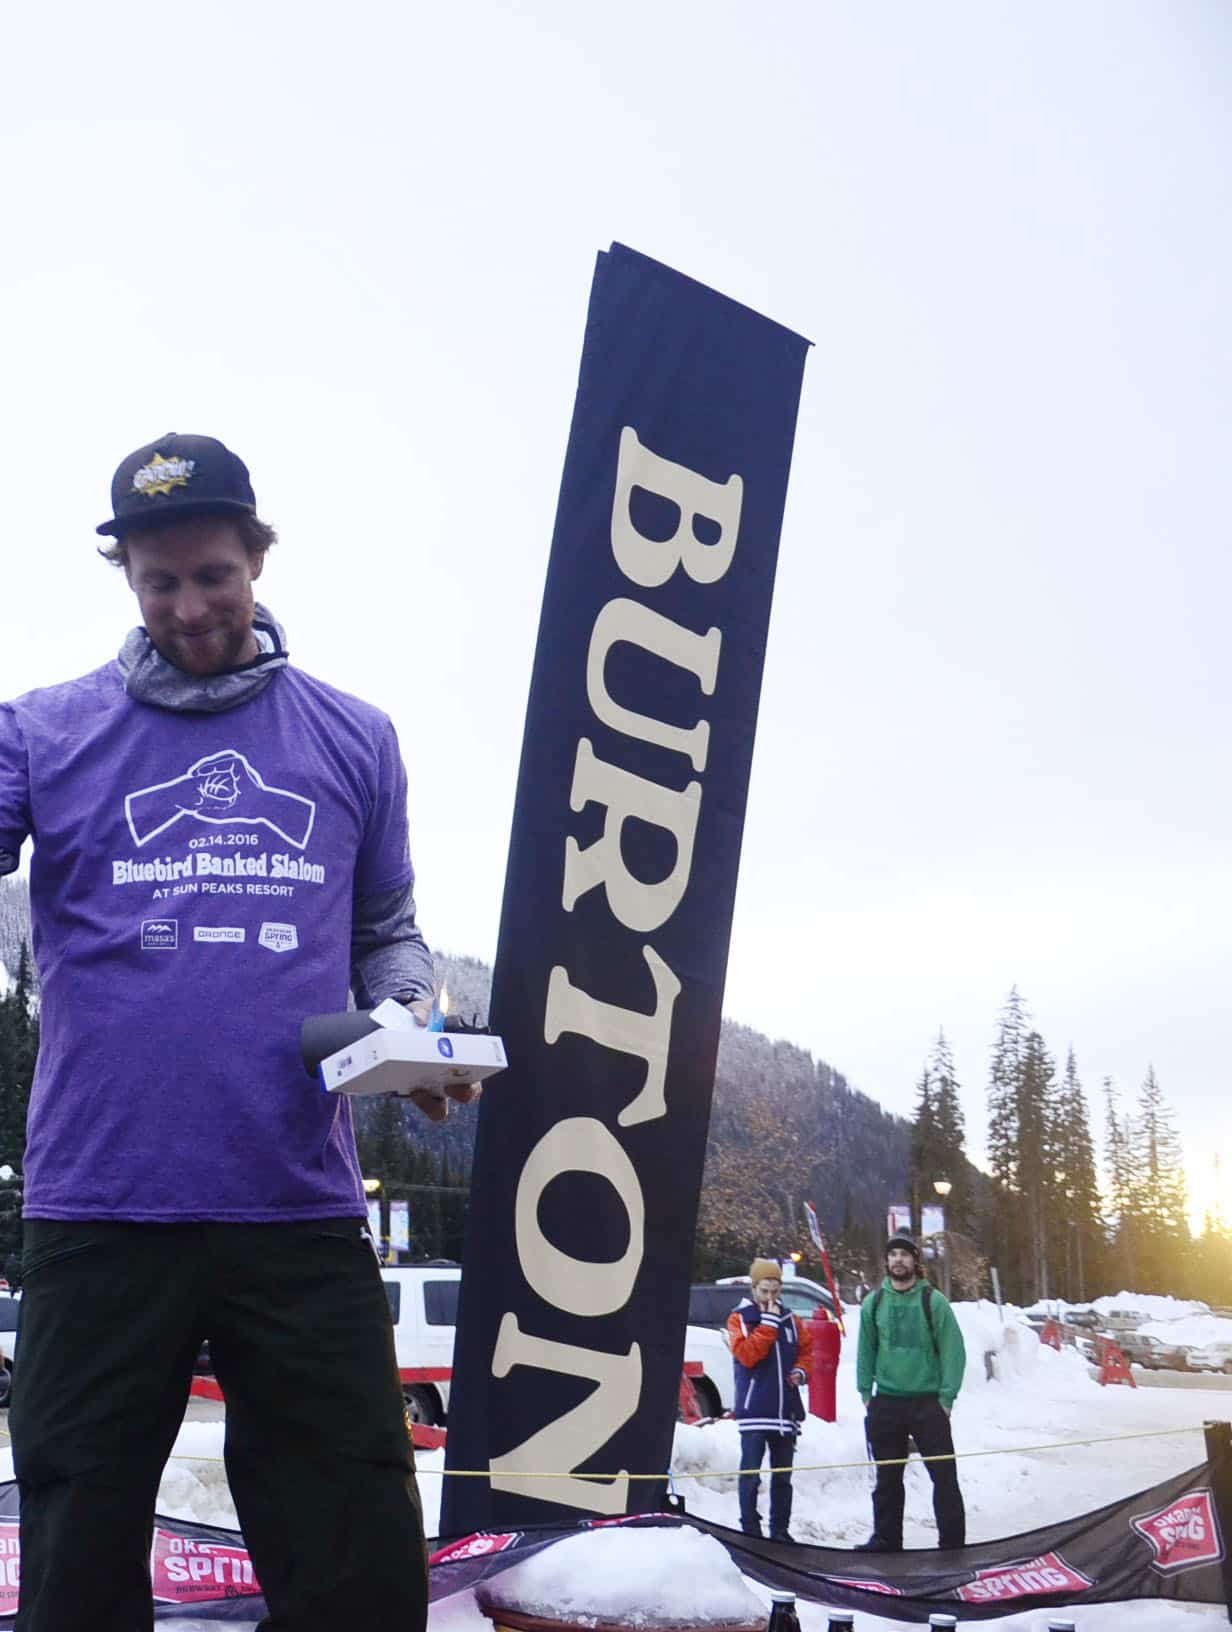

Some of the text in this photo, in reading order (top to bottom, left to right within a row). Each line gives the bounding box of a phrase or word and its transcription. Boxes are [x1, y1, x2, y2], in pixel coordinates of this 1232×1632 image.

[189, 833, 259, 849] 02.14.2016
[112, 852, 325, 885] Bluebird Banked Slalom
[152, 882, 295, 900] AT SUN PEAKS RESORT
[489, 426, 743, 1515] BURTON
